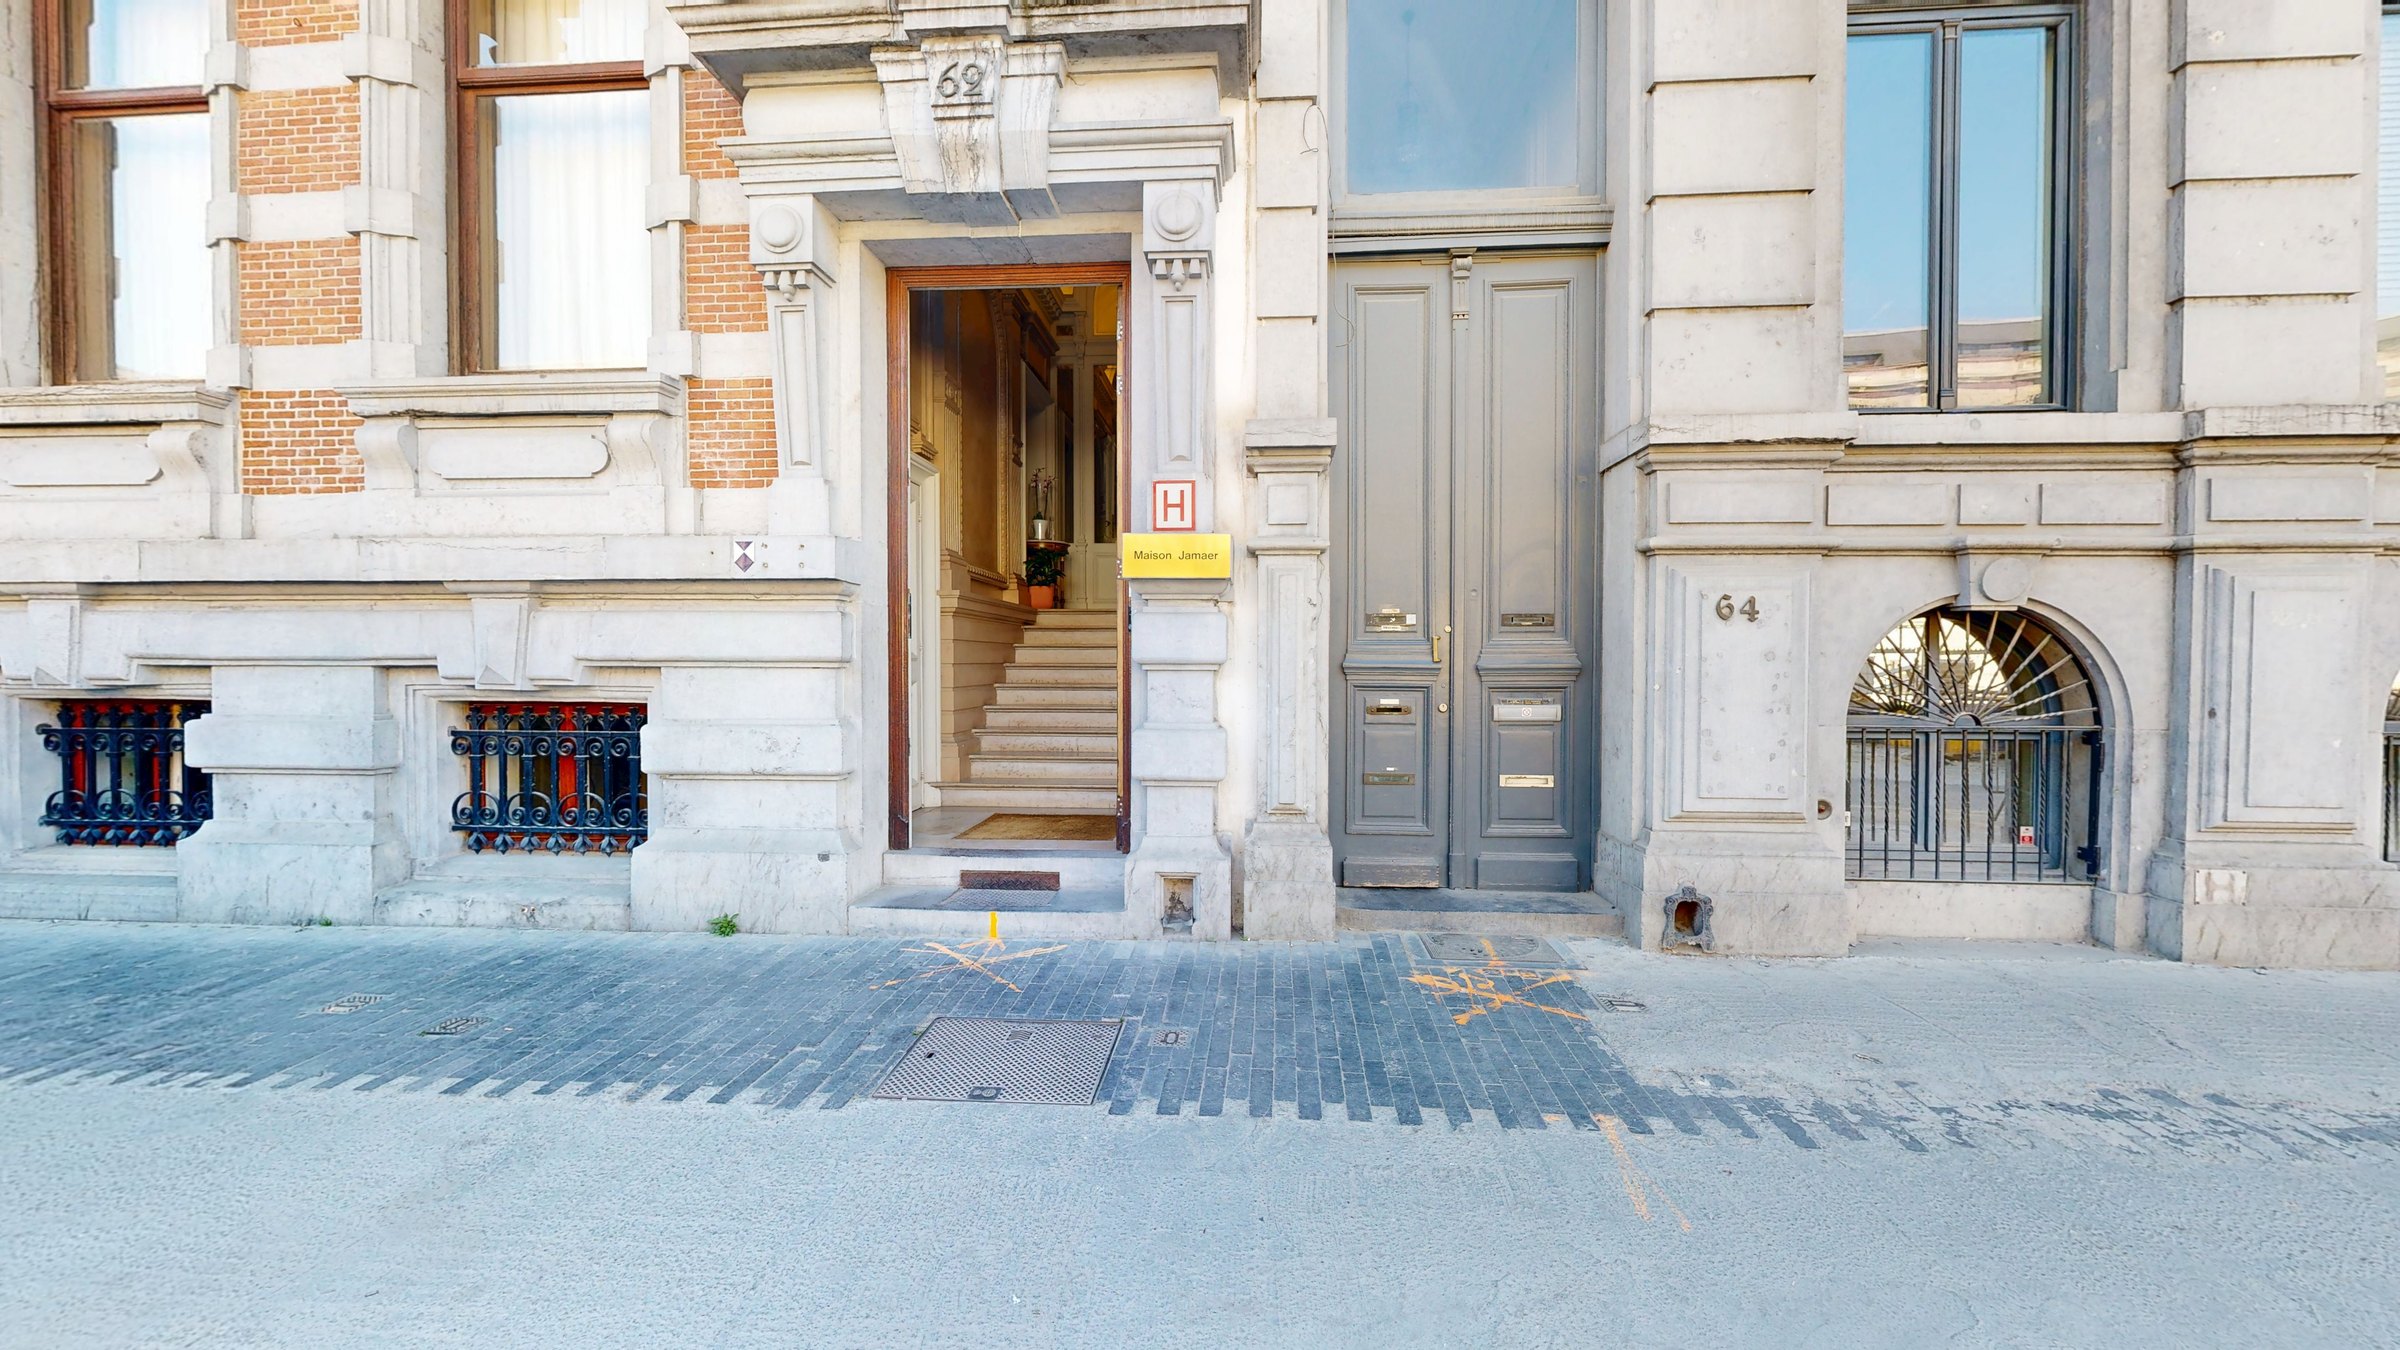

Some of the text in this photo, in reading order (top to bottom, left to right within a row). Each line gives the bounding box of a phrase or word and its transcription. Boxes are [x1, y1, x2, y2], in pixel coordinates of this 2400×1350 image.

[937, 61, 984, 98] 62
[1163, 489, 1185, 522] H
[1133, 550, 1219, 560] Maison Jamaer
[1715, 593, 1760, 623] 64
